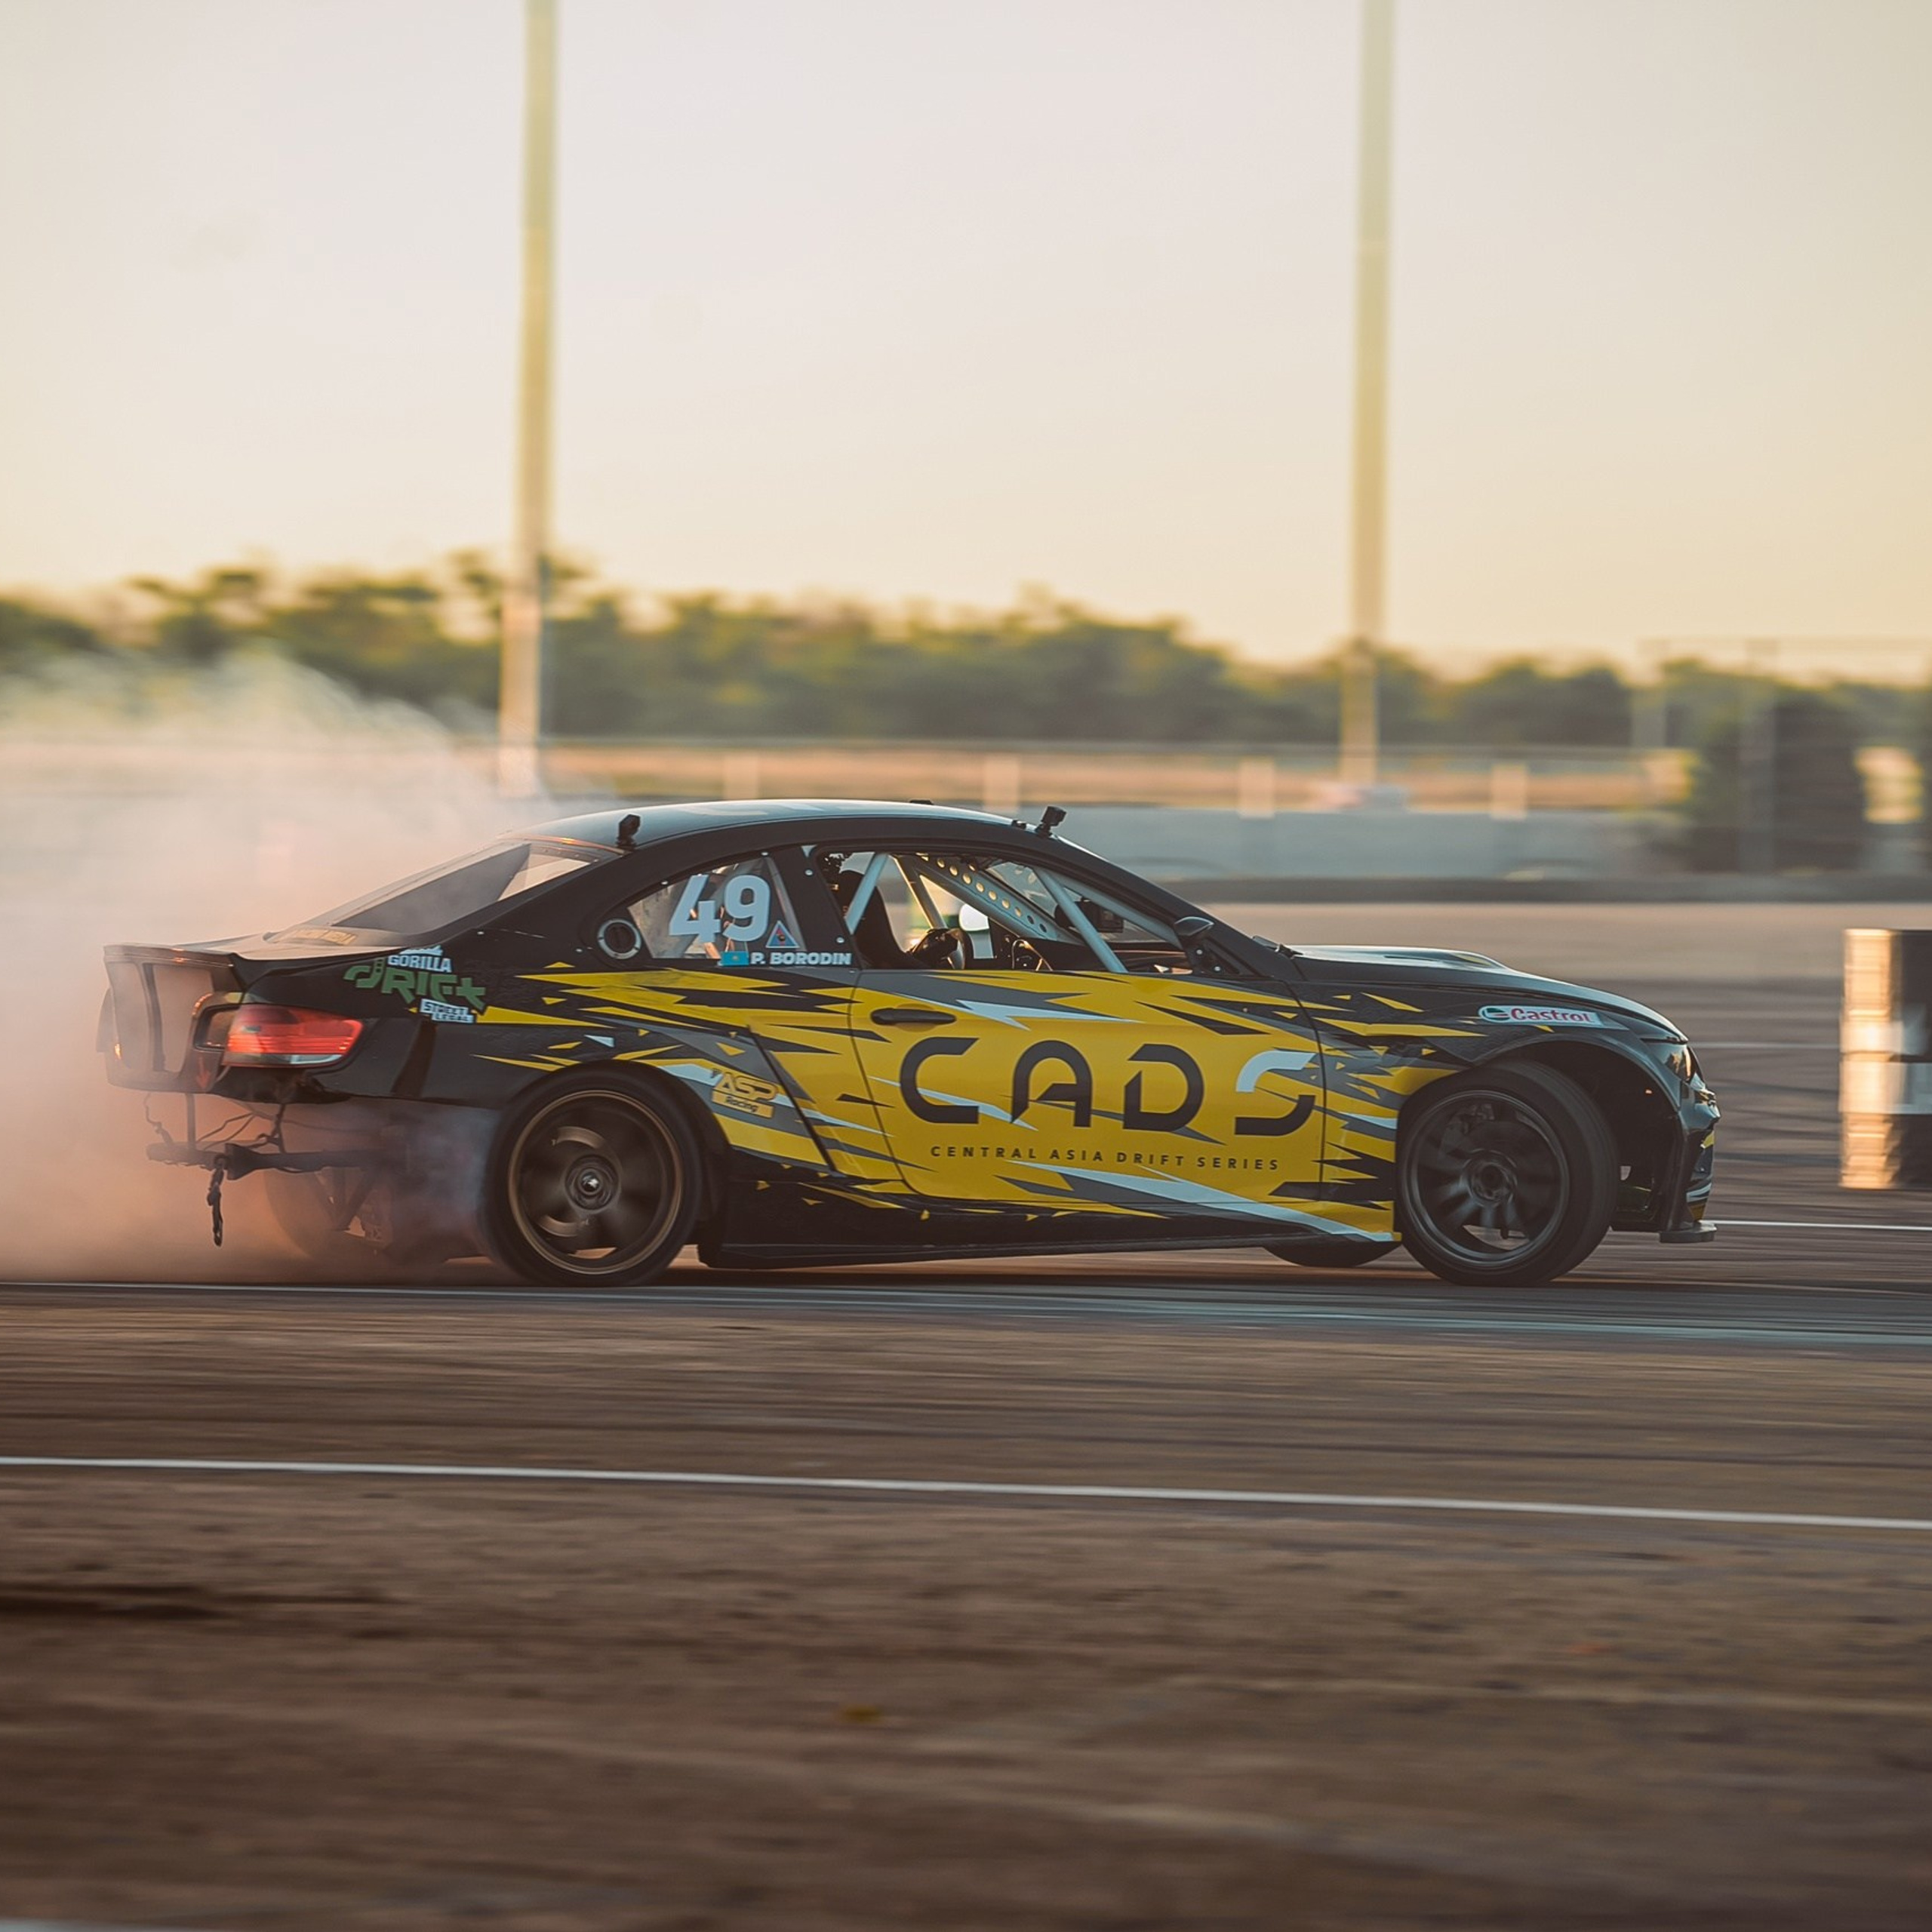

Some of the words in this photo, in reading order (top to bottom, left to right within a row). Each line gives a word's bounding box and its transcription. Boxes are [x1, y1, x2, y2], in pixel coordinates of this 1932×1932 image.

[669, 875, 771, 943] 49
[387, 955, 452, 973] GORILLA
[750, 952, 765, 964] P.
[770, 952, 851, 965] BORODIN
[1511, 1008, 1592, 1023] Castrol
[712, 1072, 778, 1102] ASP
[899, 1036, 1317, 1136] CADS
[931, 1146, 1036, 1159] CENTRAL
[1050, 1149, 1103, 1161] ASIA
[1116, 1152, 1184, 1166] DRIFT
[1197, 1157, 1278, 1170] SERIES
